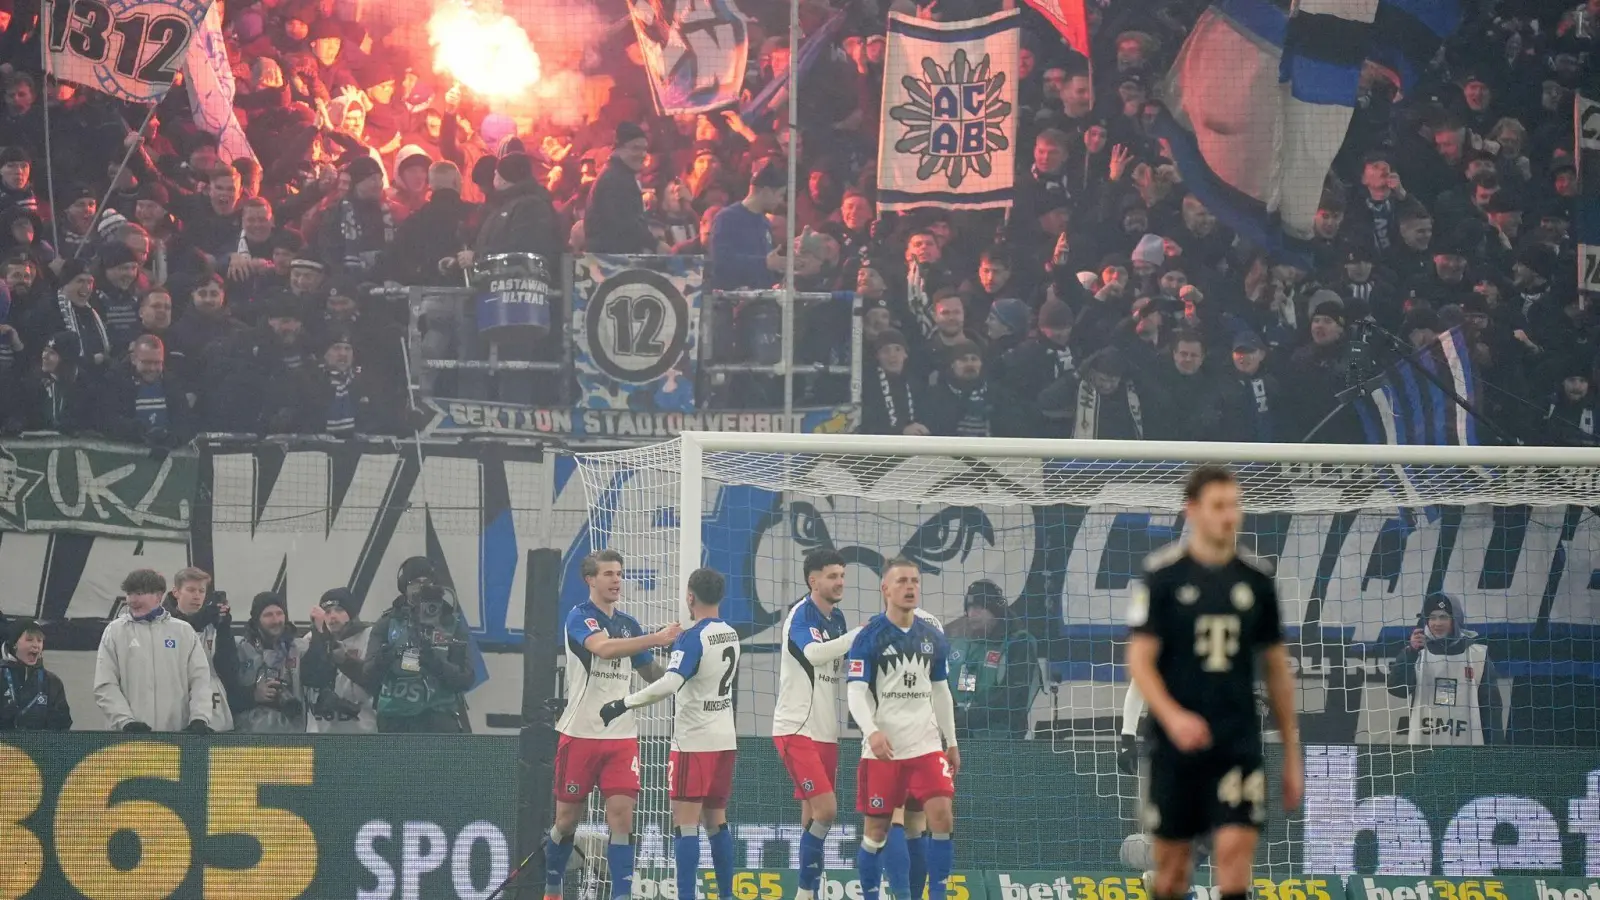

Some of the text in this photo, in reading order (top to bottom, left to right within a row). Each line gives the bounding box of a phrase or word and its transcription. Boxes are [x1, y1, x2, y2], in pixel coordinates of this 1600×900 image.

[49, 0, 191, 86] 1312
[606, 294, 667, 357] 12
[449, 403, 805, 435] SEKTION STADIONVERBOT
[718, 646, 736, 697] 2
[1422, 717, 1468, 737] SMF
[1217, 766, 1267, 807] 44
[999, 873, 1148, 900] bet365
[1363, 877, 1508, 900] bet365
